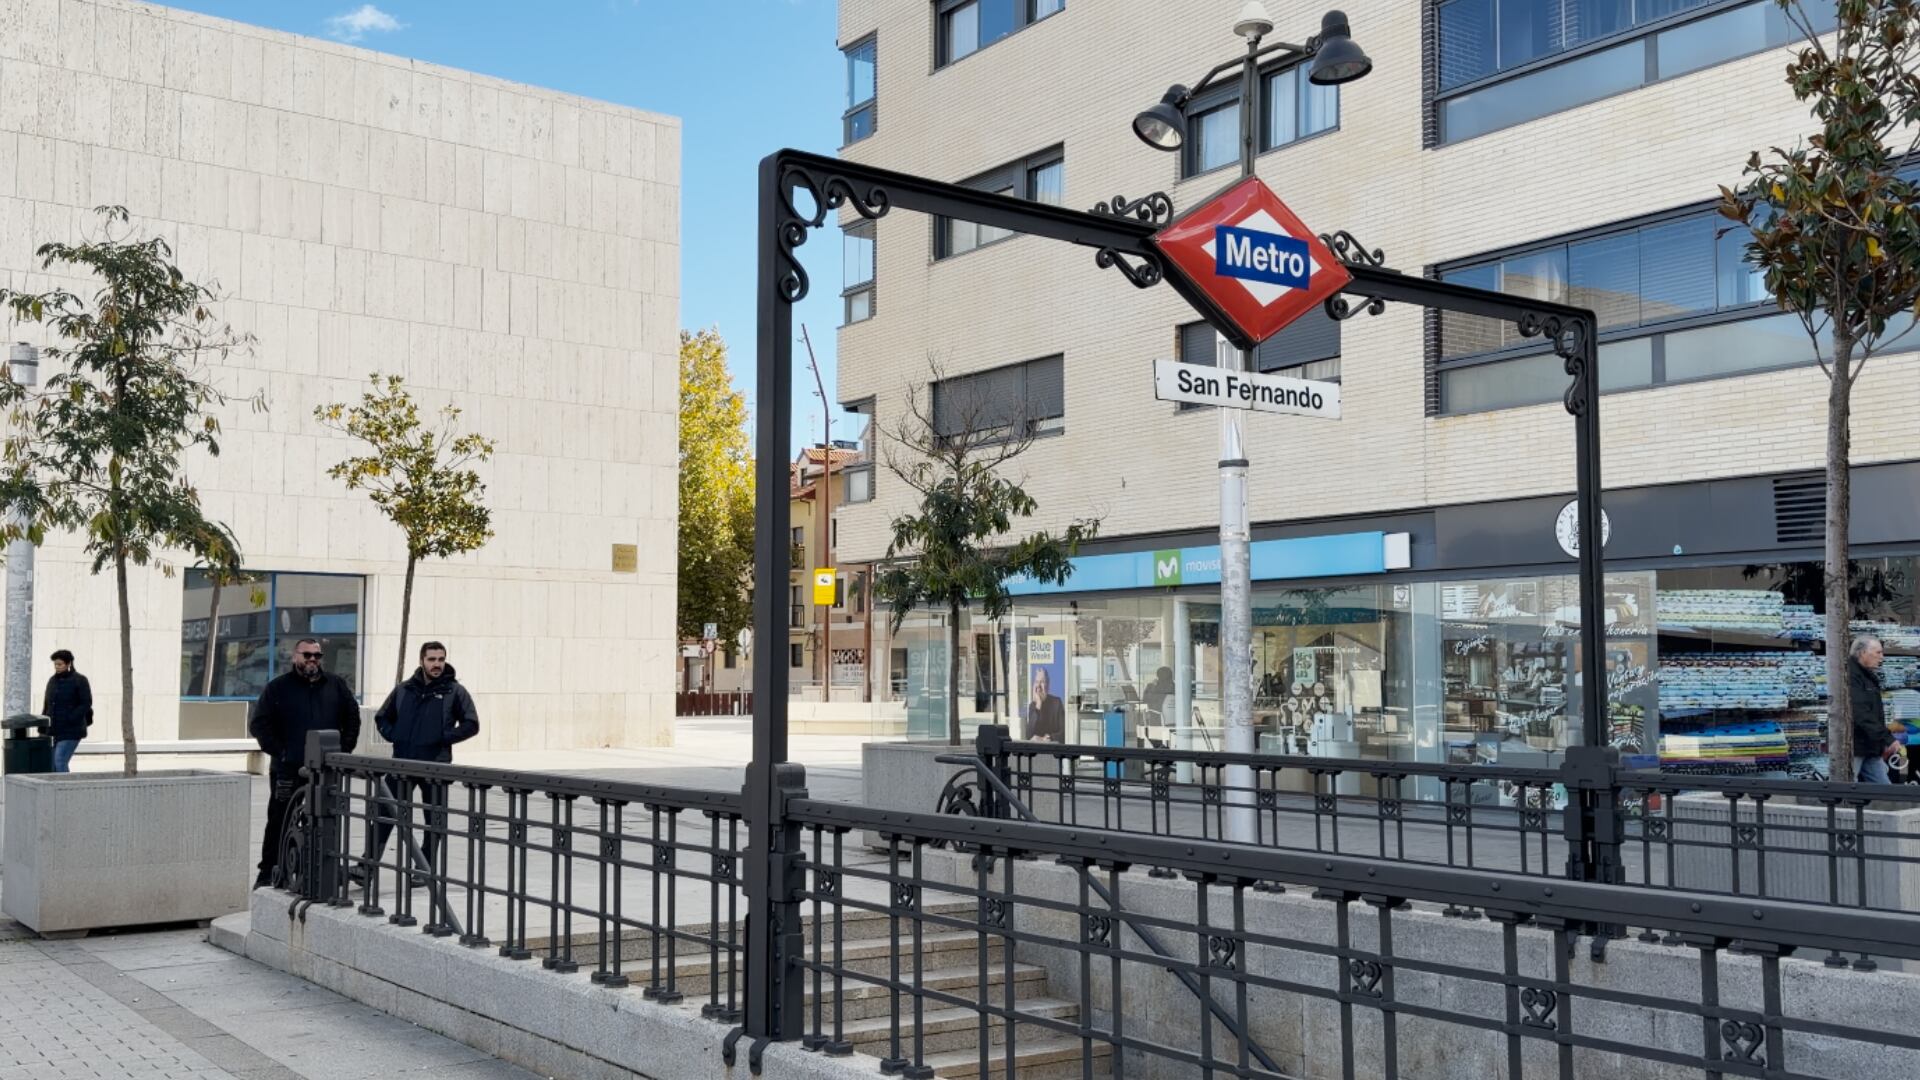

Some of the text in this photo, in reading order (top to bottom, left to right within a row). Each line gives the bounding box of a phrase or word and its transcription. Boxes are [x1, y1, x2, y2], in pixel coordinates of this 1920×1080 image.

[1225, 233, 1304, 278] Metro
[1177, 369, 1323, 410] San Fernando
[1030, 639, 1052, 651] Blue
